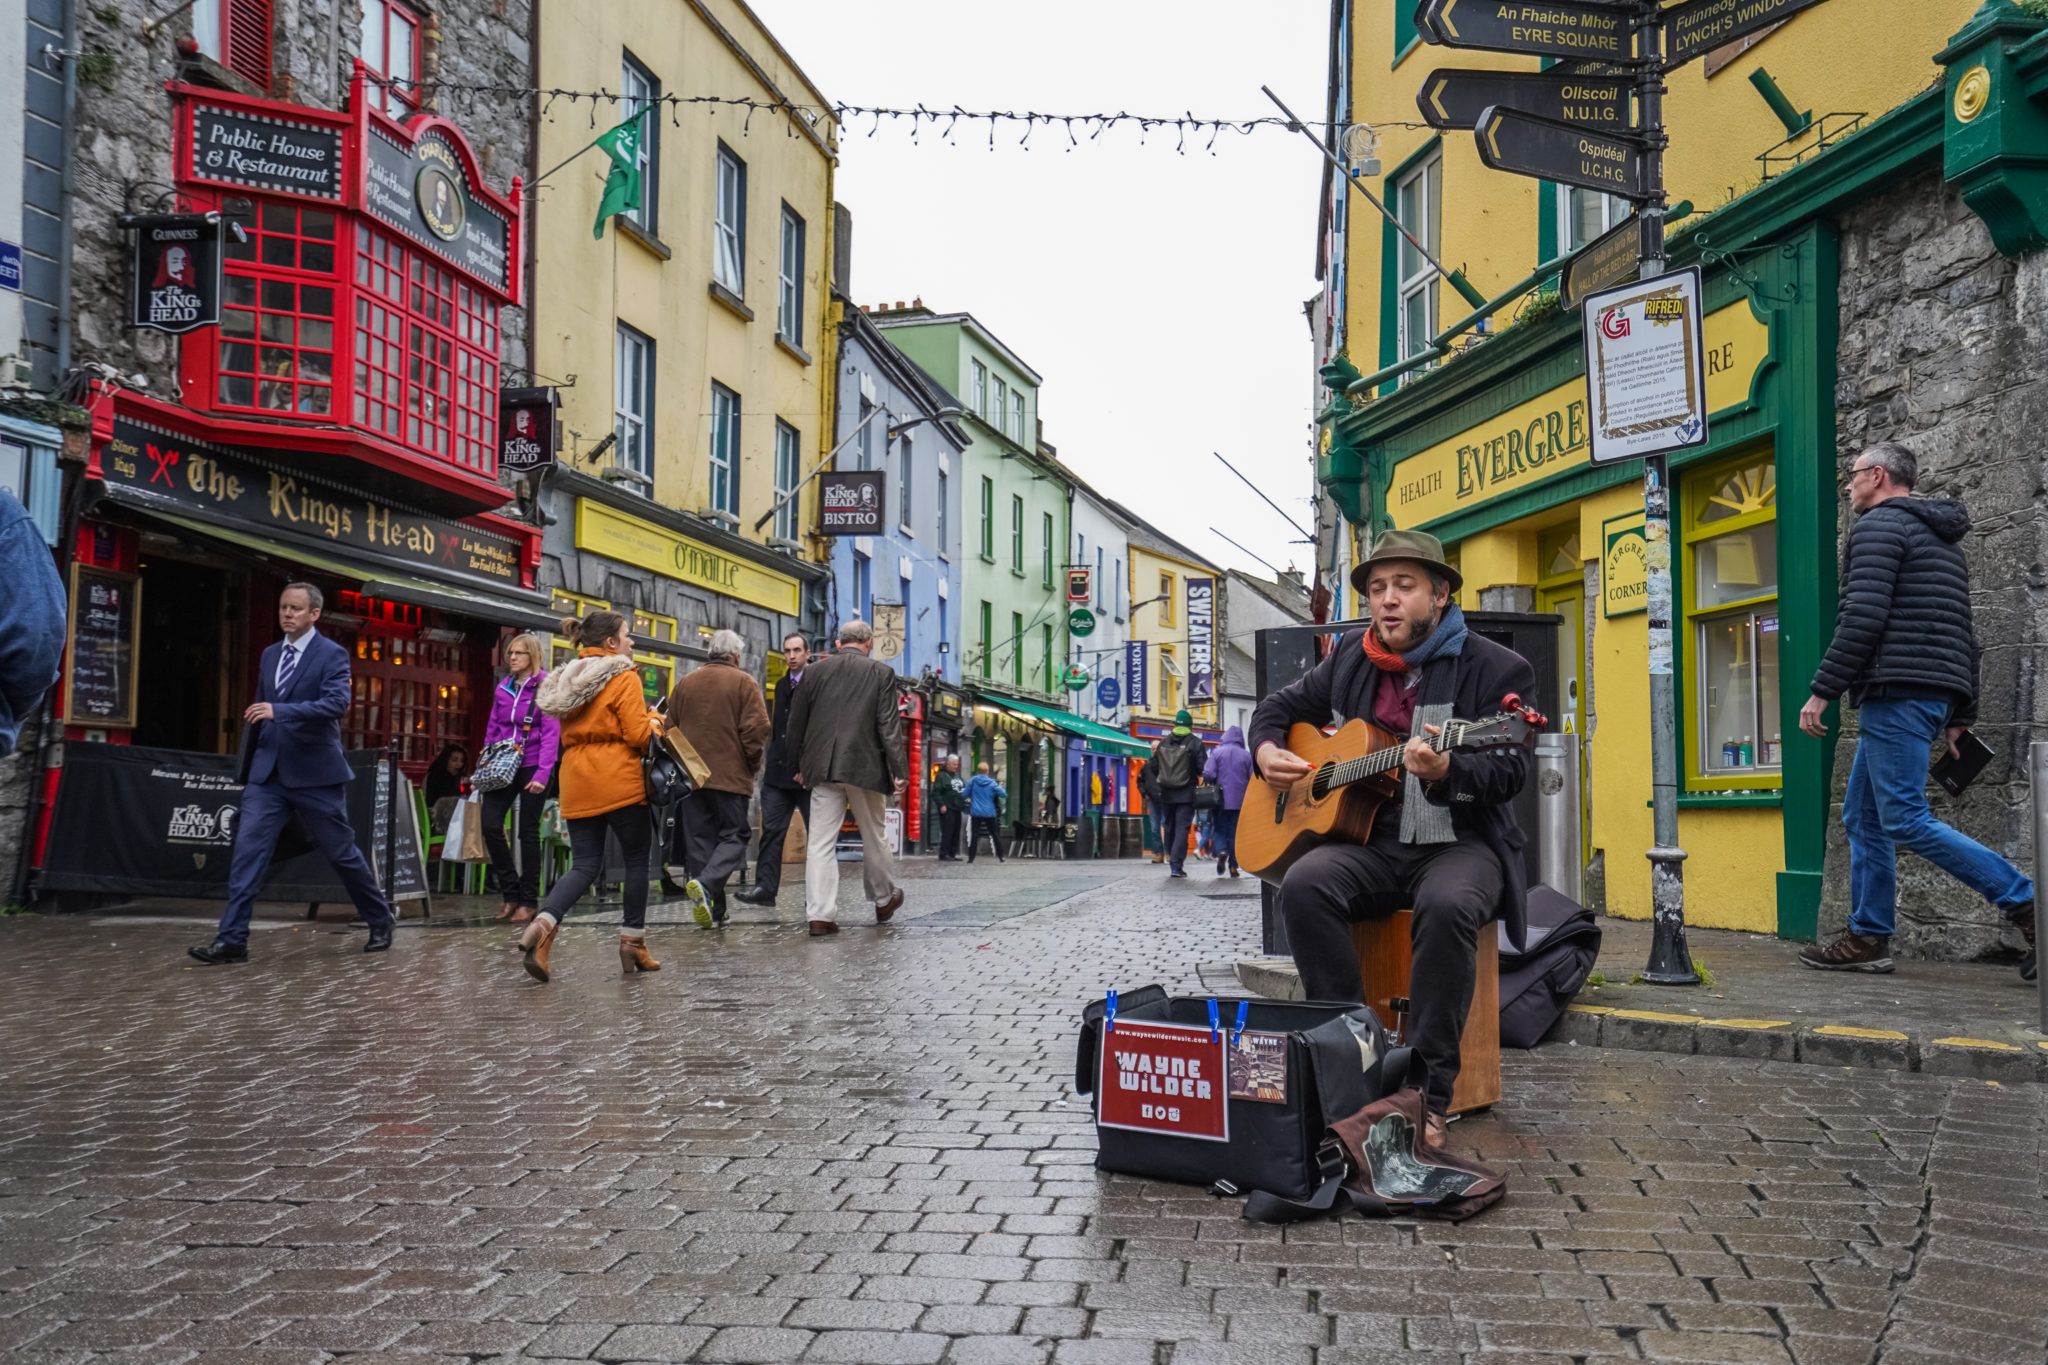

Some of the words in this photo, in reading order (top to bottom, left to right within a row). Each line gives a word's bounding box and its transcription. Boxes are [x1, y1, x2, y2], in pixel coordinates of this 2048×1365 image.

[1497, 5, 1517, 20] An
[1521, 8, 1577, 26] Fhaiche
[1581, 13, 1617, 31] Mhór
[1512, 26, 1552, 43] EYRE
[1556, 30, 1619, 50] SQUARE
[1676, 15, 1733, 51] LYNCH'S
[1561, 86, 1618, 101] Ollscoil
[1563, 106, 1619, 120] N.U.I.G.
[209, 124, 267, 151] Public
[269, 134, 325, 161] House
[1579, 140, 1627, 162] Ospidéal
[205, 149, 224, 167] &
[226, 149, 330, 183] Restaurant
[418, 142, 454, 170] CHARLES
[1581, 160, 1627, 183] U.C.H.G.
[152, 228, 199, 241] GUINNESS
[150, 308, 198, 322] HEAD
[1645, 300, 1683, 314] RIFREDI
[111, 438, 139, 456] Since
[1400, 470, 1442, 505] HEALTH
[1456, 400, 1589, 499] EVERGRE
[504, 453, 538, 463] HEAD
[187, 453, 245, 501] The
[267, 471, 353, 538] Kings
[366, 501, 436, 556] Head
[824, 498, 855, 507] HEAD
[824, 512, 877, 525] BISTRO
[1609, 581, 1647, 601] CORNER
[1188, 586, 1212, 674] SWEATERS
[1132, 642, 1142, 705] PORTWEST
[168, 823, 209, 838] HEAD
[1115, 1029, 1208, 1044] www.waynewildermusic.com
[1252, 1037, 1278, 1046] WAYNE
[1114, 1051, 1201, 1079] WAYNE
